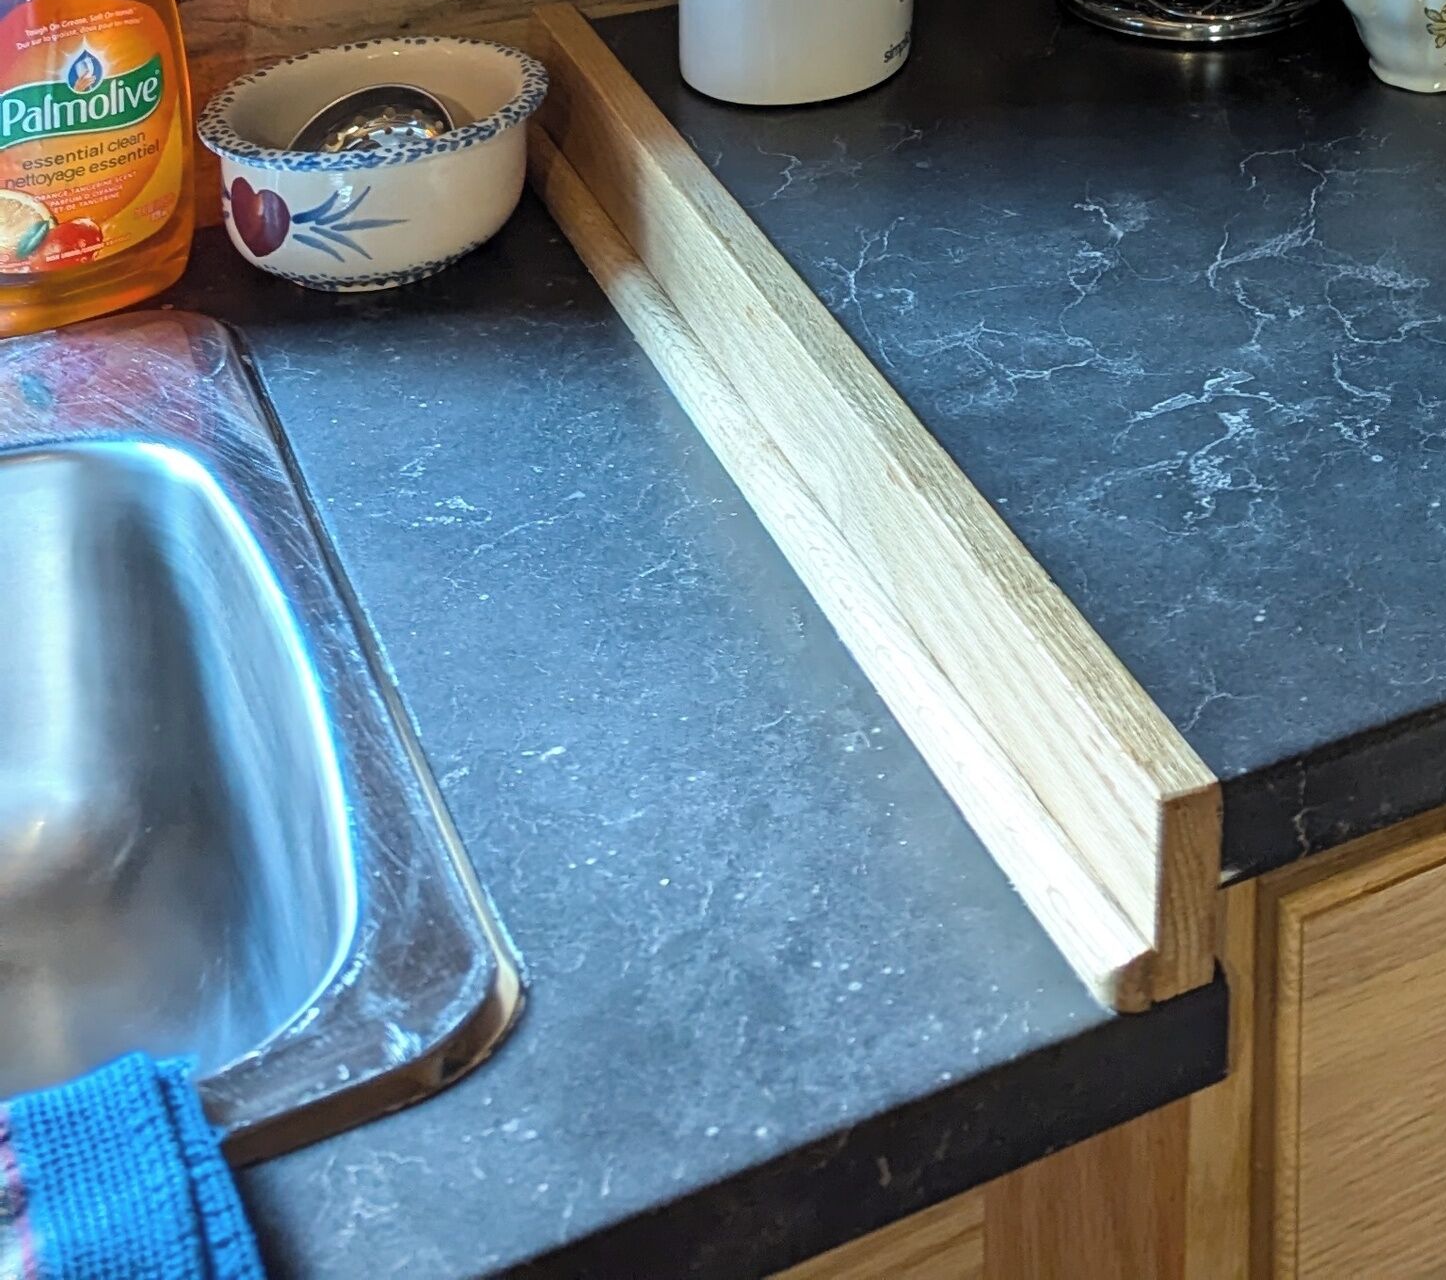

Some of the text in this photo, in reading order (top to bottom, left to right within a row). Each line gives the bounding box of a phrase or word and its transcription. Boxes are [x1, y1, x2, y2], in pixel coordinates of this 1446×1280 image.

[15, 40, 32, 50] Dur
[25, 26, 48, 37] Tough
[49, 23, 60, 31] On
[90, 13, 103, 23] Soft
[2, 76, 158, 137] Palmolive
[5, 139, 160, 190] nettoyage essentiel
[22, 131, 146, 171] essential clean
